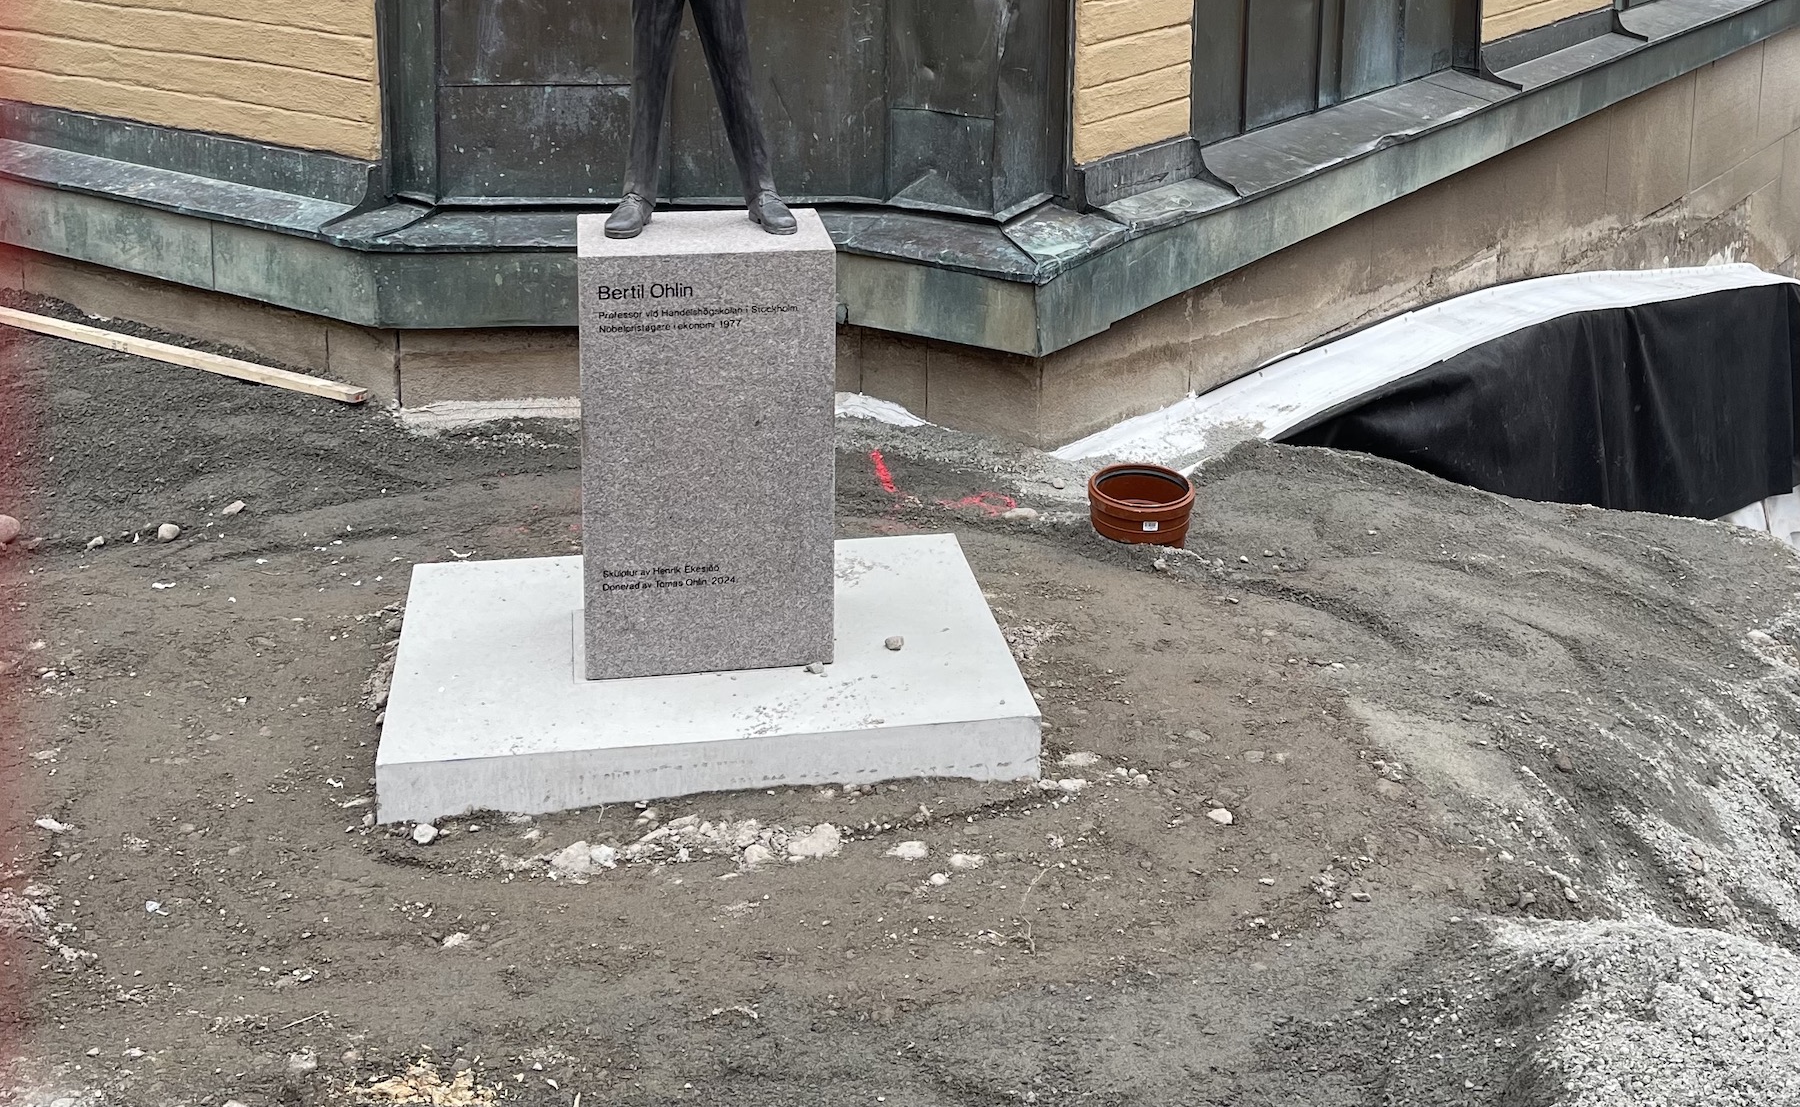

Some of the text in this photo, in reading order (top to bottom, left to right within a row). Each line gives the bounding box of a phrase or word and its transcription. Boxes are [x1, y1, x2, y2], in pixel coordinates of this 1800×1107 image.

[598, 282, 693, 300] Bertil Ohlin
[599, 311, 642, 319] Professor
[646, 309, 659, 318] vid
[751, 304, 798, 315] Stockholm
[719, 319, 742, 329] 1977
[652, 566, 682, 575] Henrik
[711, 576, 736, 585] 2024
